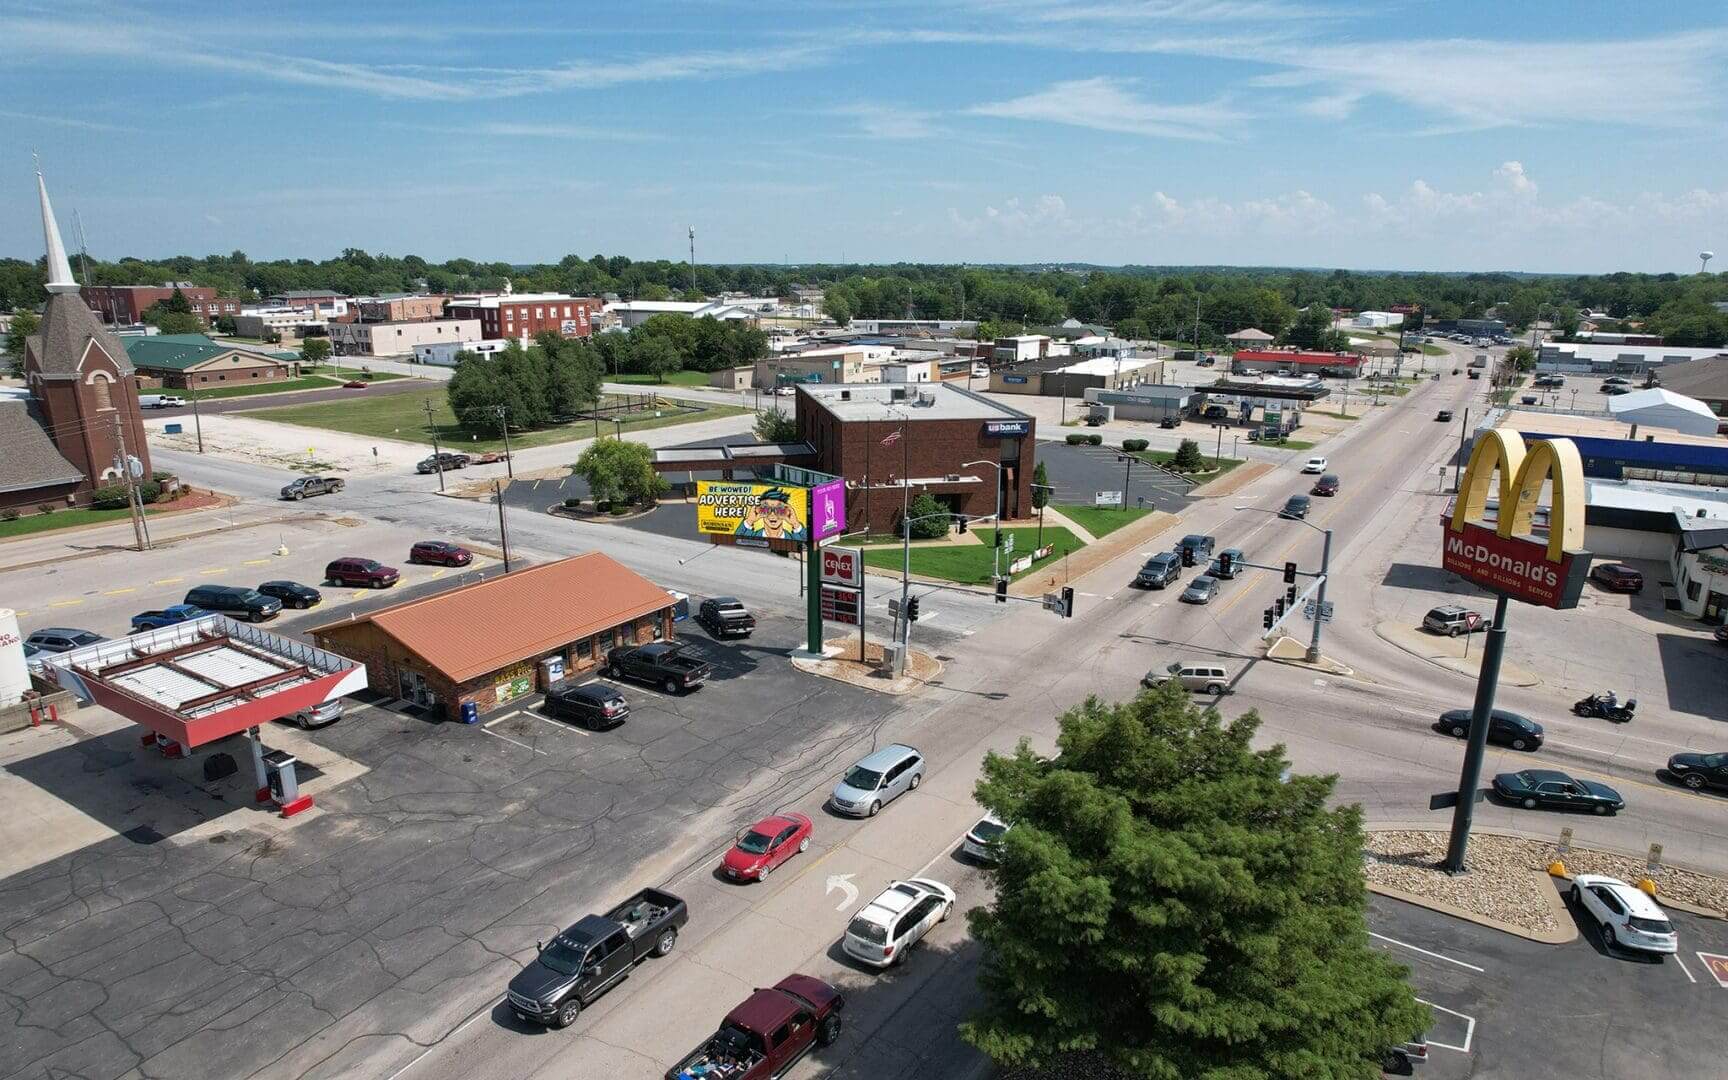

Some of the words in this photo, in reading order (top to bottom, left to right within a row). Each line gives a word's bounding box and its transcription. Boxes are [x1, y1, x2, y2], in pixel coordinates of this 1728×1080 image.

[720, 486, 752, 494] WOWED!
[699, 494, 761, 506] ADVERTISE
[714, 506, 748, 518] HERE!
[825, 560, 851, 571] CENEX
[1447, 537, 1558, 587] McDonald's
[1528, 585, 1553, 599] SERVED
